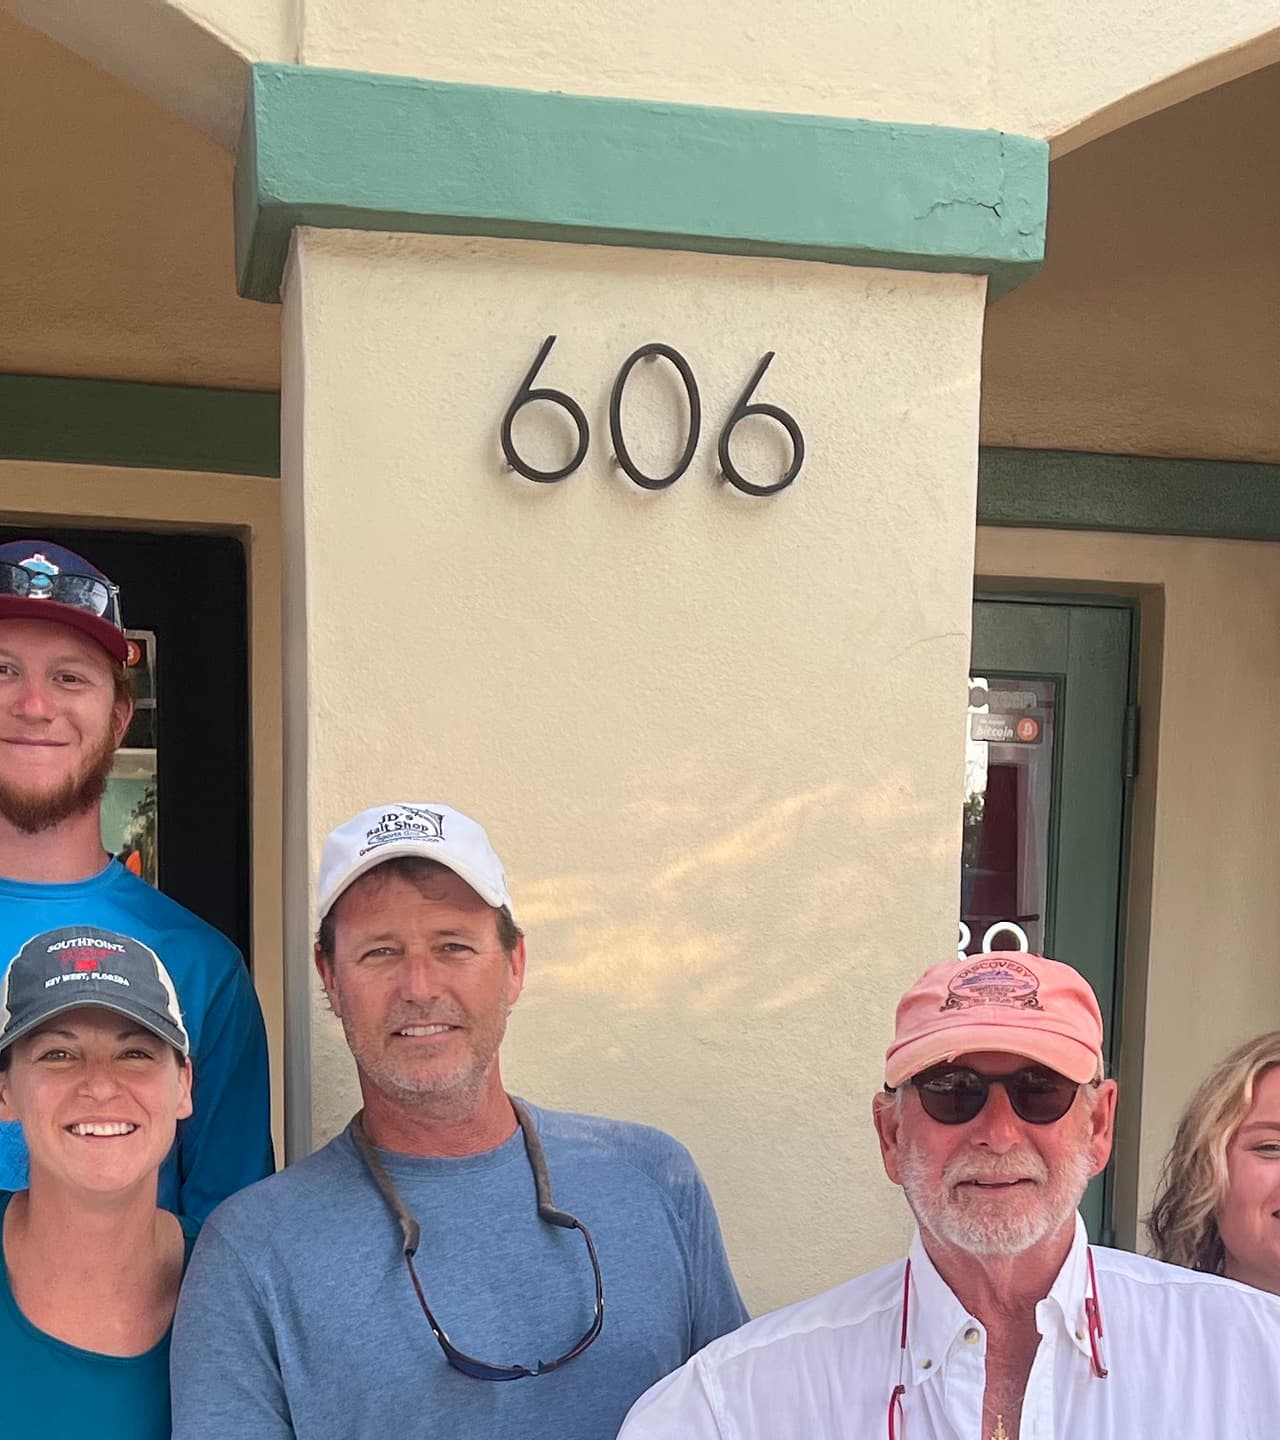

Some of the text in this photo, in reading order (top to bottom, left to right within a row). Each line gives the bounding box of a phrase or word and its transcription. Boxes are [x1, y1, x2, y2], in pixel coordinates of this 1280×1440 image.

[502, 335, 805, 497] 606
[976, 725, 1014, 738] bitcoin
[394, 821, 429, 833] Shop
[46, 937, 126, 953] SOUTHPOINT
[958, 961, 1032, 979] DISCOVERY
[45, 976, 61, 989] KEY
[91, 972, 131, 987] FLORIDA
